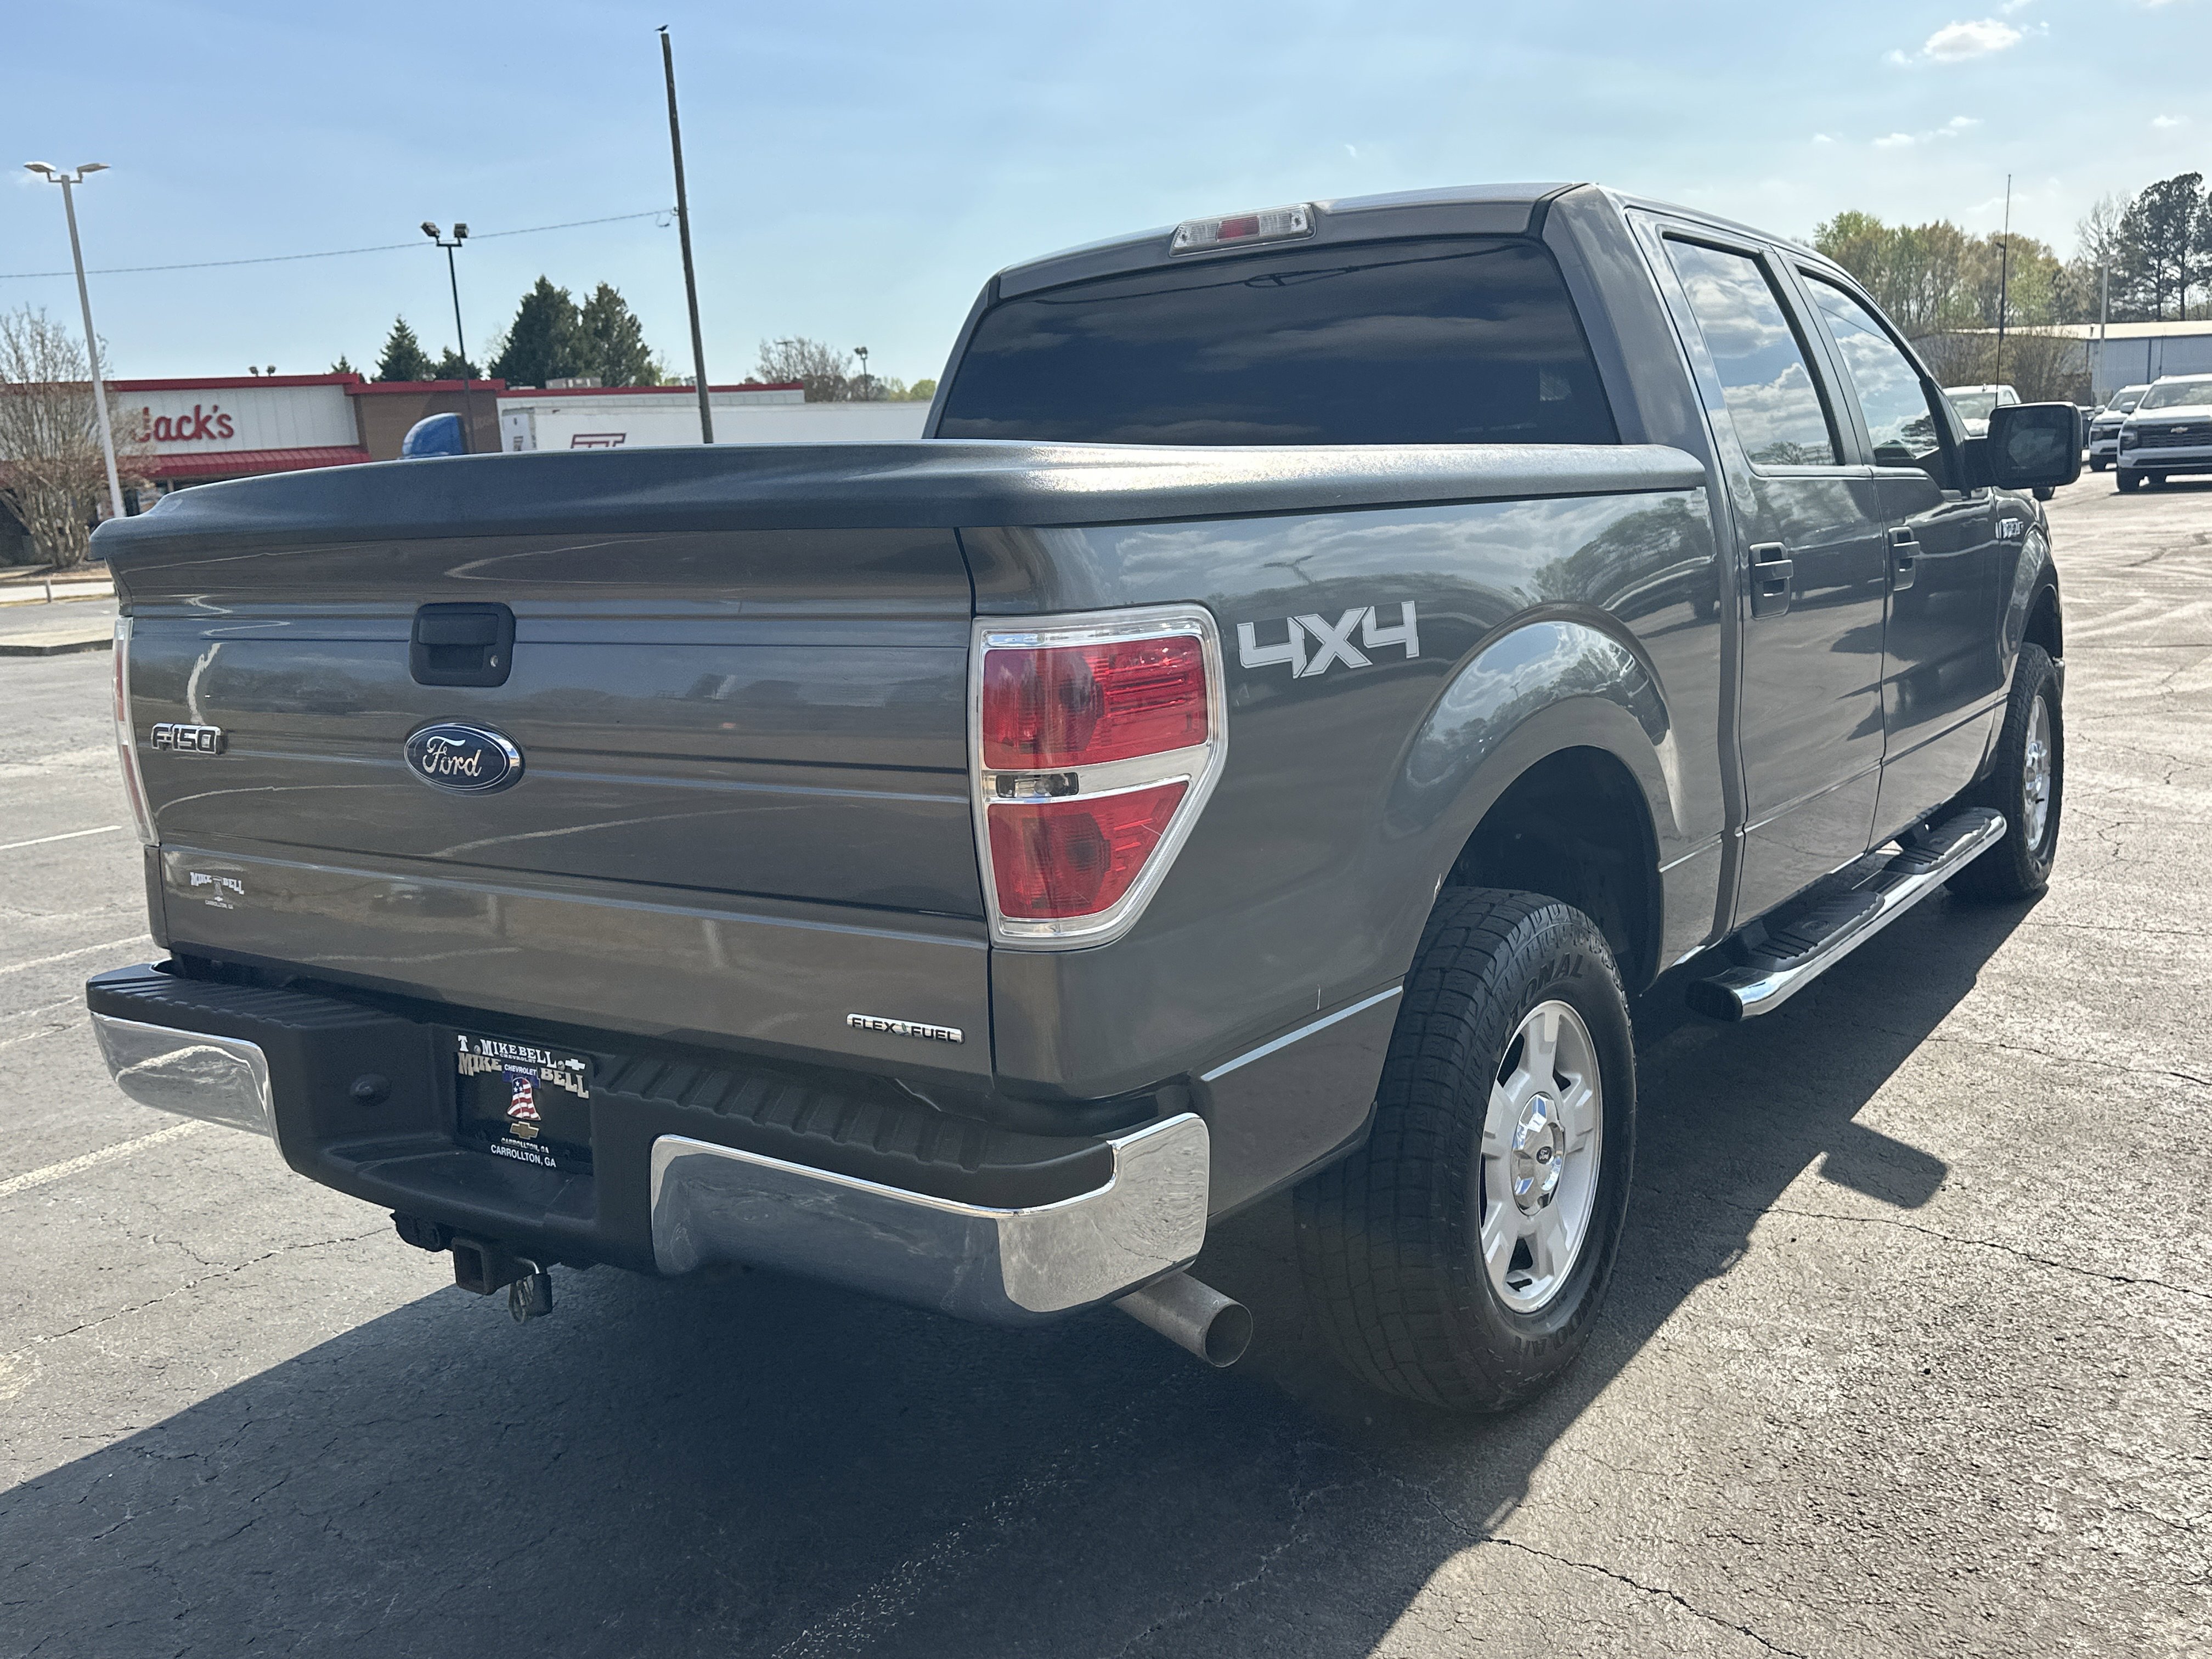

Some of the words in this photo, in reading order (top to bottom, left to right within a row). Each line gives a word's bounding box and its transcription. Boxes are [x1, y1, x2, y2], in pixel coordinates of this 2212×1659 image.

[151, 723, 221, 754] F-150
[422, 736, 482, 777] Ford
[852, 1017, 896, 1034] FLEX
[911, 1025, 958, 1042] FUEL
[480, 1039, 517, 1057] MIKE
[518, 1046, 557, 1069] BELL
[458, 1052, 502, 1076] MIKE
[540, 1067, 589, 1099] BELL
[504, 1064, 537, 1076] CHEVROLET
[490, 1144, 543, 1166] CARROLLTON,
[544, 1157, 556, 1167] GA
